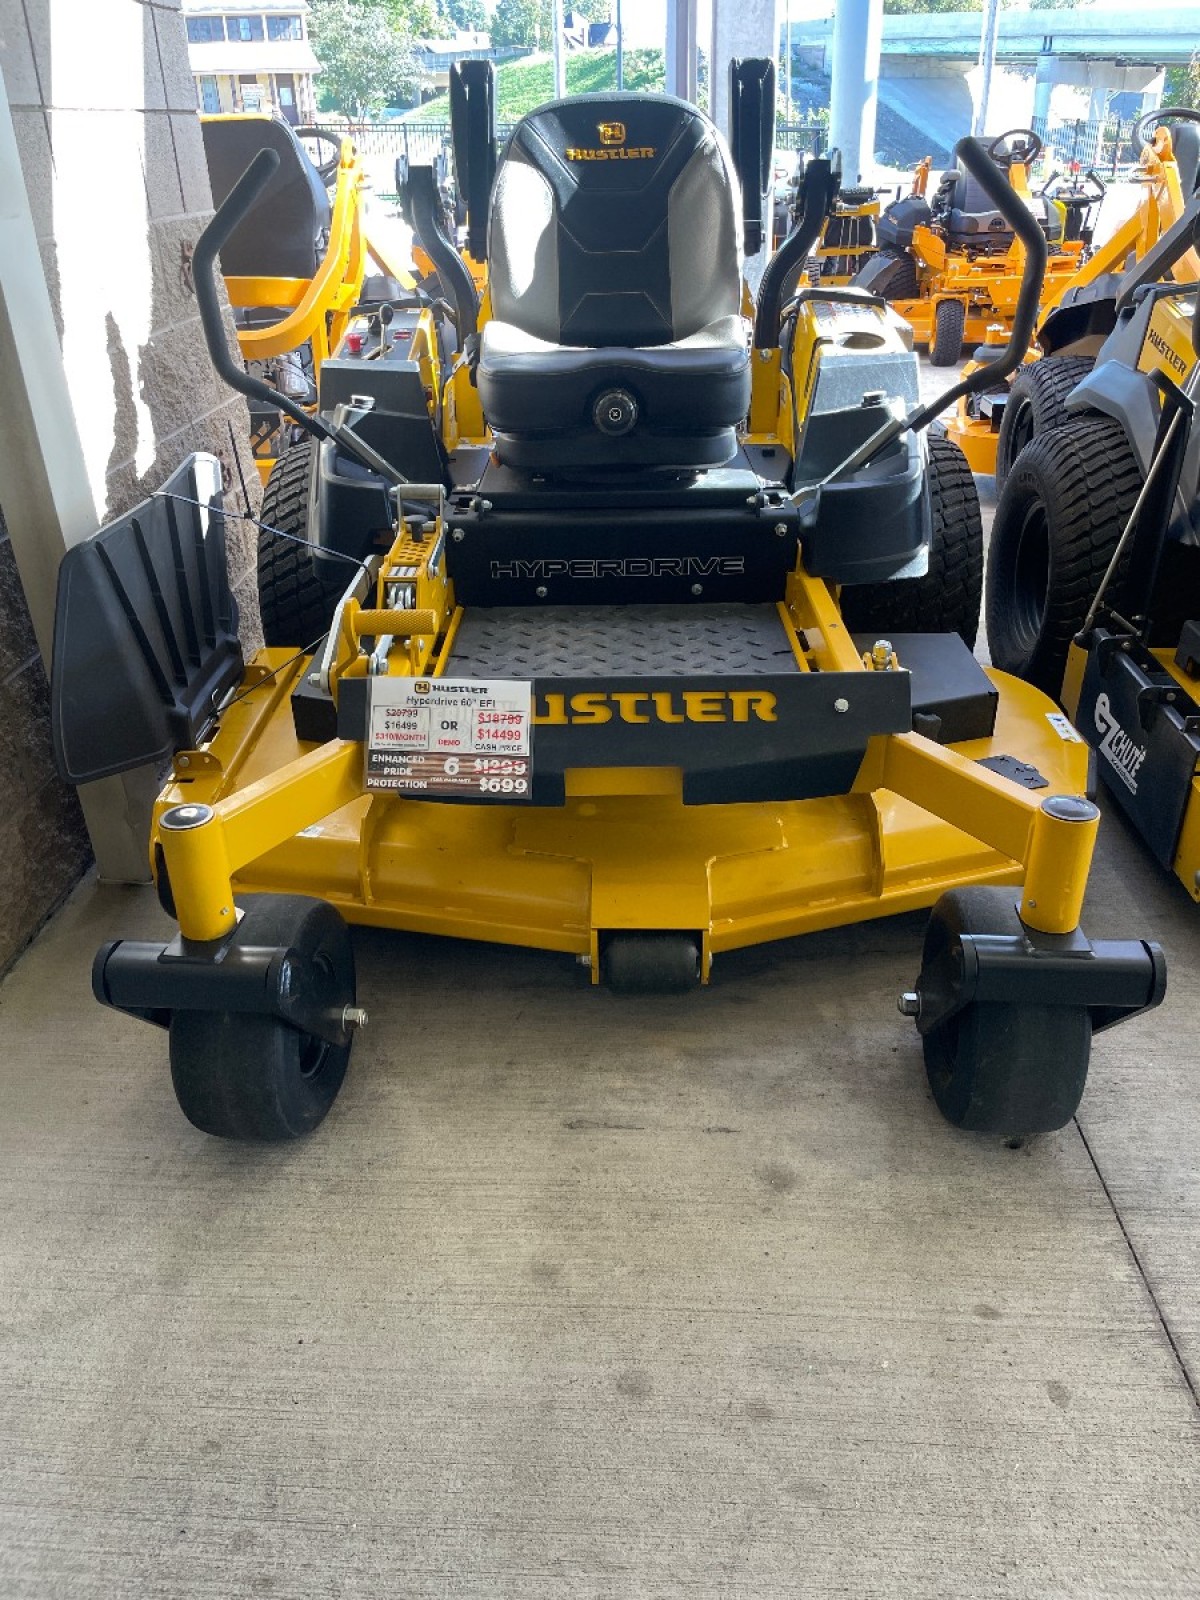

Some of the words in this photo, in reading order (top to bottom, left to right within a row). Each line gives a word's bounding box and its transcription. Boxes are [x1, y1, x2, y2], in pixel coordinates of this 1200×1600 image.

[566, 147, 654, 161] HUSTLER
[1148, 328, 1187, 376] HUSTLER
[490, 556, 745, 578] HYPERDRIVE
[432, 684, 488, 694] HUSTLER
[407, 696, 458, 706] Hyperdrive
[480, 700, 496, 708] EFI
[531, 691, 778, 725] USTLER
[385, 721, 418, 730] $16499
[441, 720, 458, 731] OR
[477, 729, 521, 740] $14499
[474, 743, 497, 751] CASH
[371, 754, 425, 764] ENHANCED
[383, 767, 413, 776] PRIDE
[444, 757, 460, 776] 6
[474, 758, 526, 776] $1299
[367, 778, 428, 789] PROTECTION
[479, 777, 528, 794] $699
